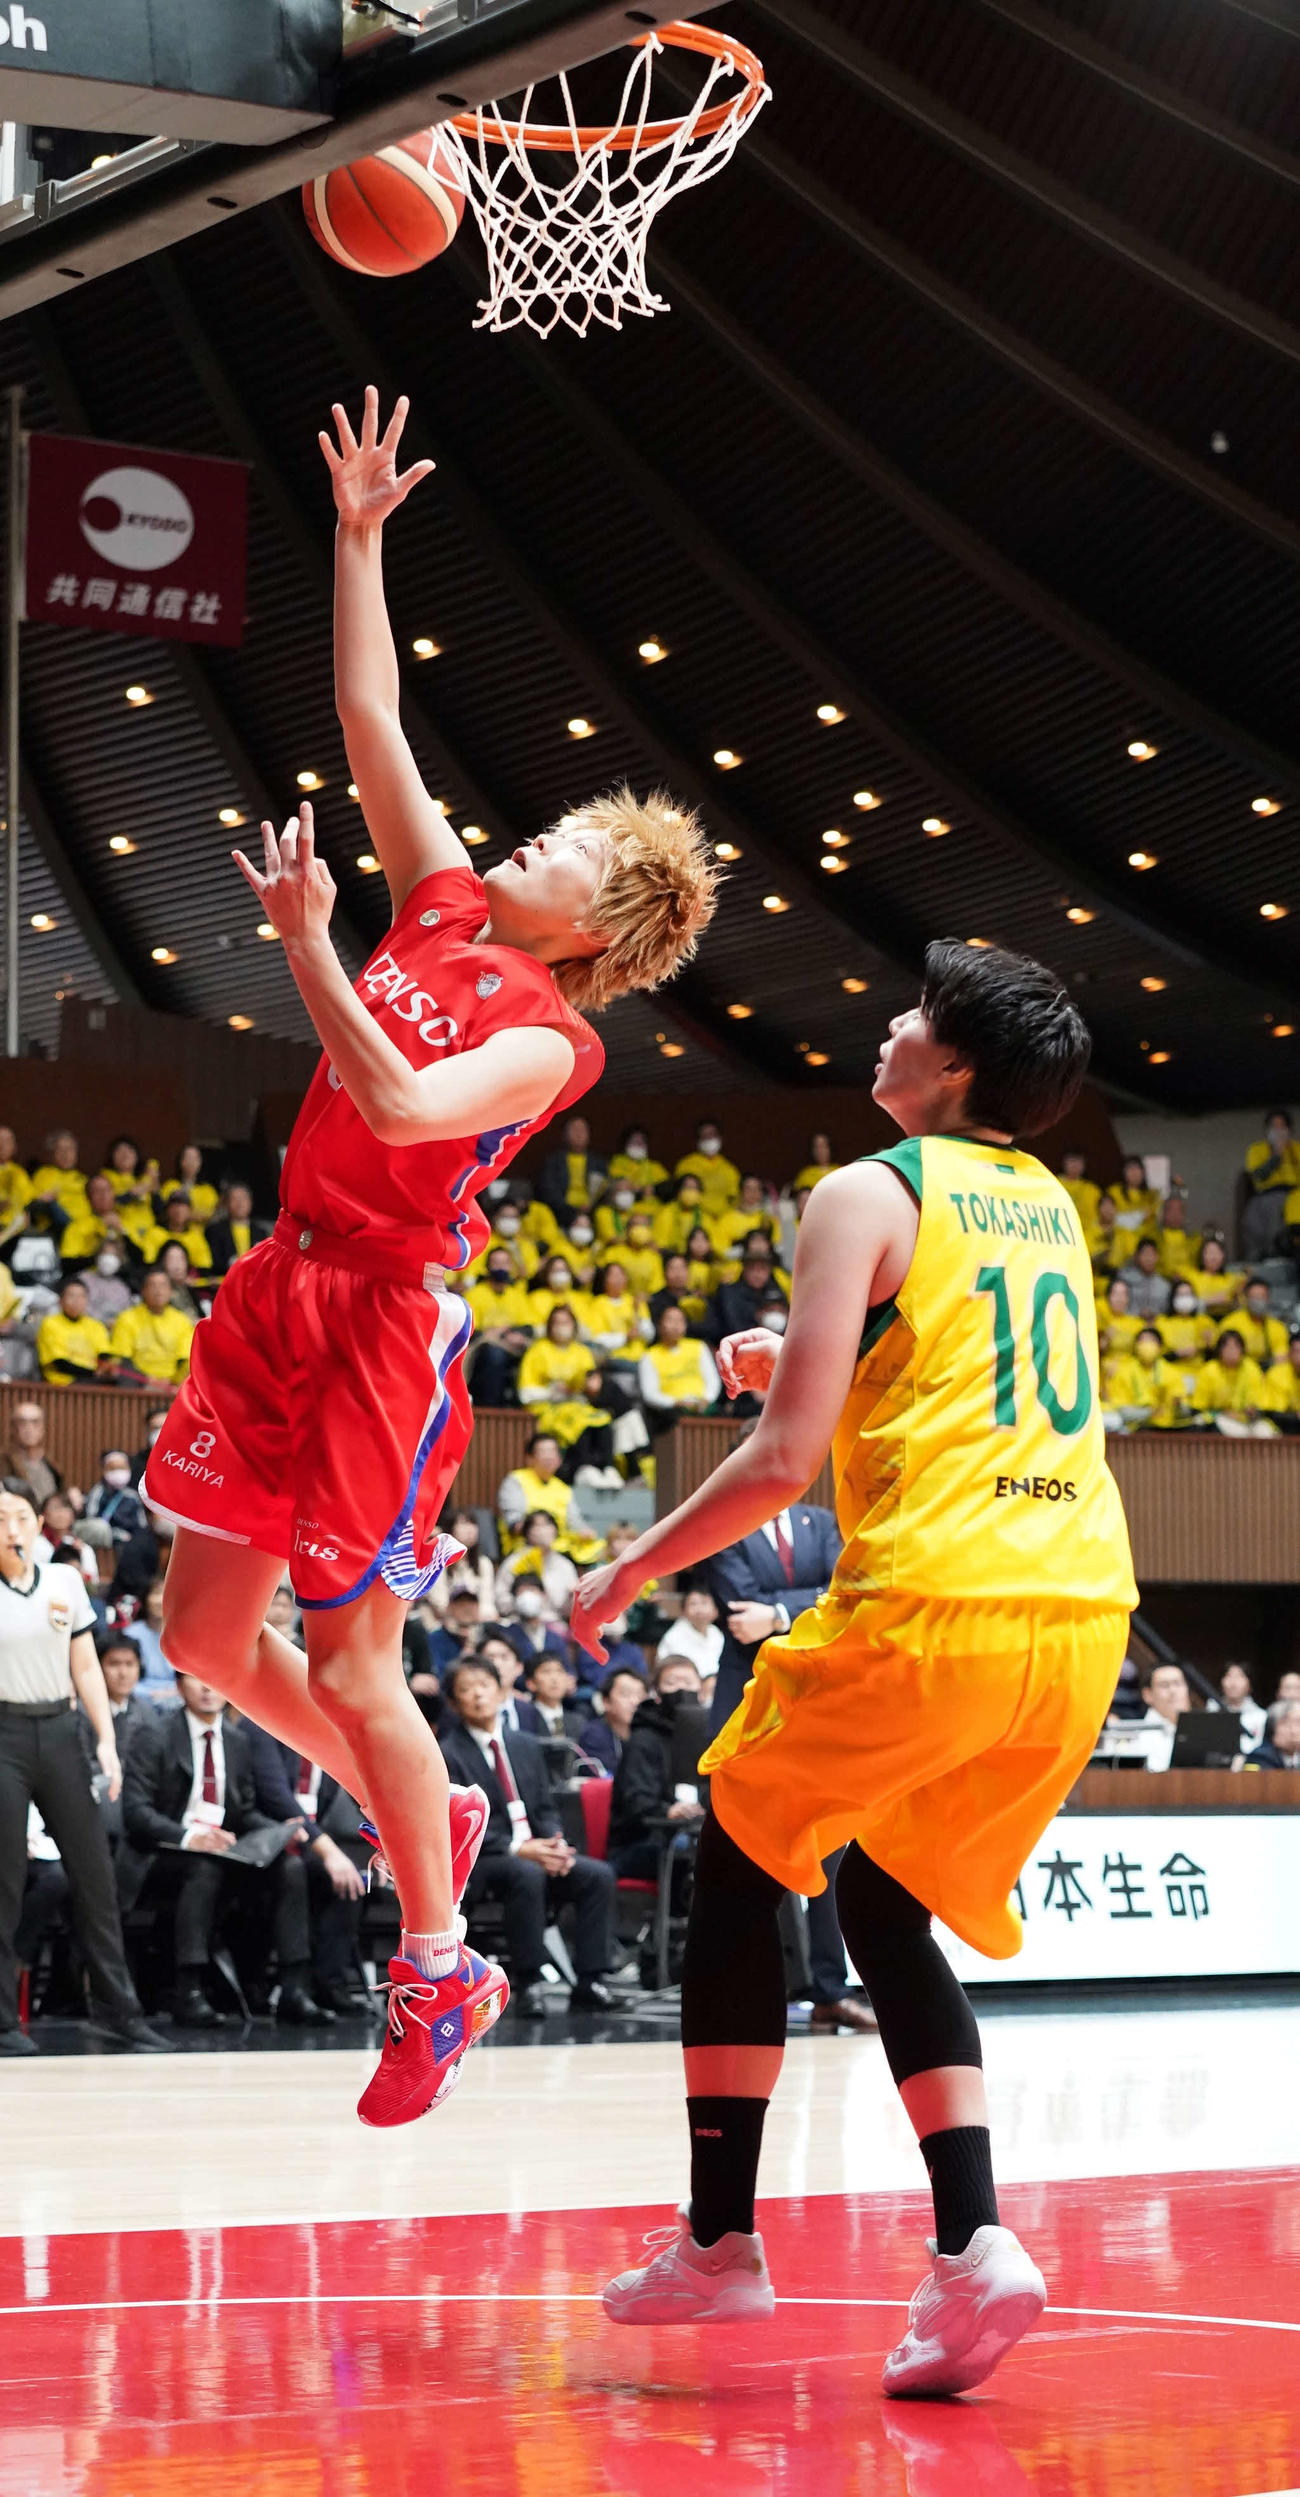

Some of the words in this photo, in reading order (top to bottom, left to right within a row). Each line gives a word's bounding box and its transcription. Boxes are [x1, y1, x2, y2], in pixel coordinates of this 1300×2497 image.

[46, 572, 222, 626] 共同通信社
[363, 951, 458, 1047] DENSO
[950, 1193, 1077, 1247] TOKASHIKI
[974, 1266, 1092, 1436] 10
[161, 1449, 225, 1489] KARIYA
[189, 1430, 217, 1459] 8
[994, 1475, 1078, 1502] ENEOS
